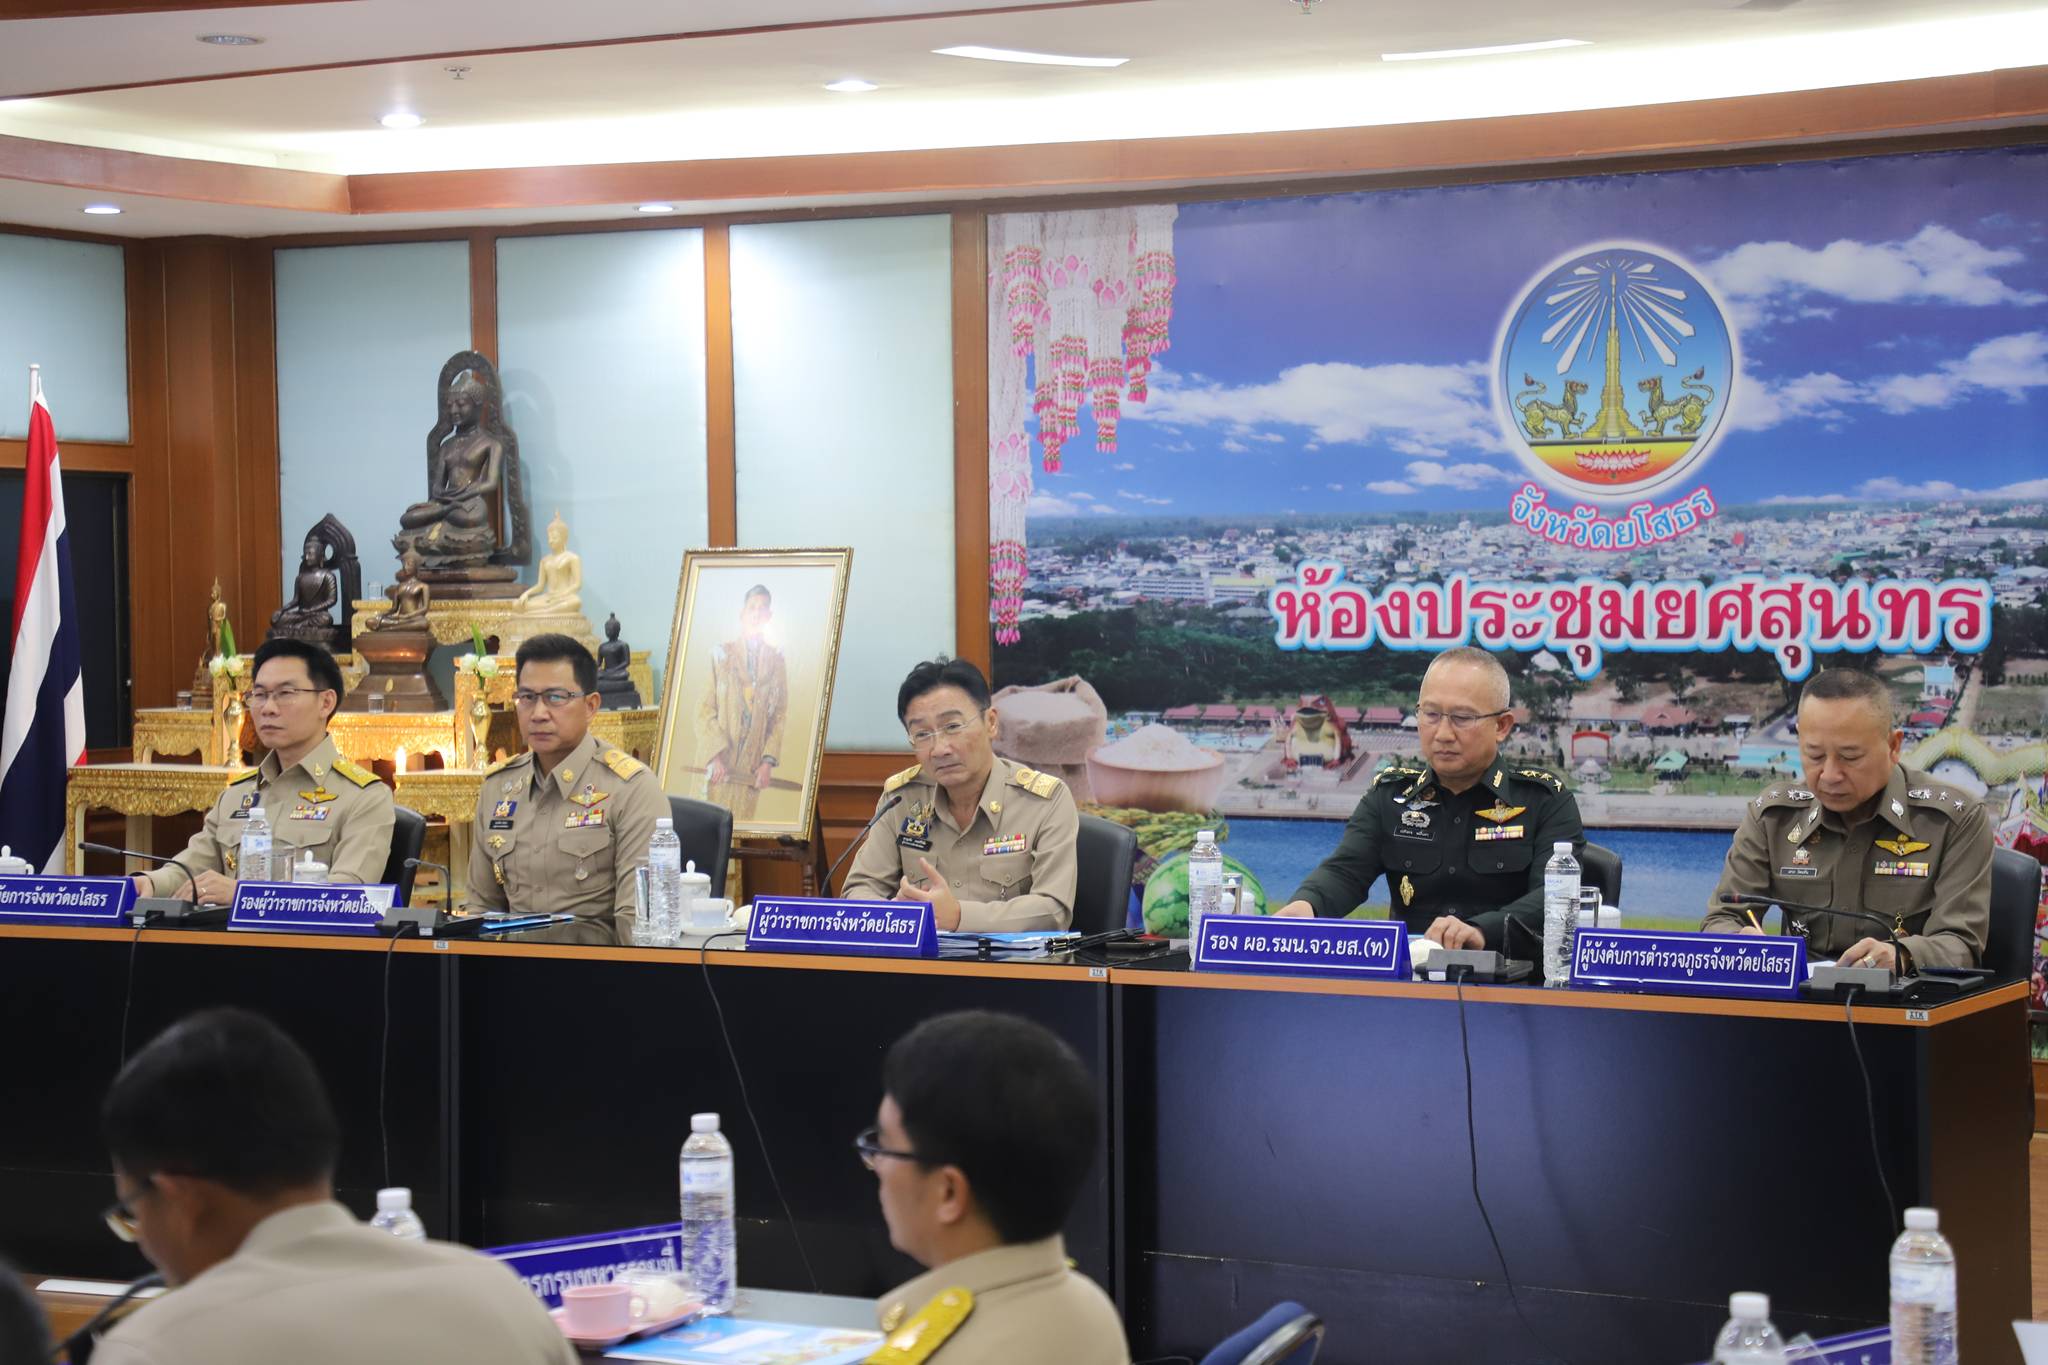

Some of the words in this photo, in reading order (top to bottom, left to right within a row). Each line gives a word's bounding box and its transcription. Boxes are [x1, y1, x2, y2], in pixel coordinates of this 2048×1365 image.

[1512, 483, 1716, 549] จังหวัดยโสธร
[1274, 561, 1991, 675] ห้องประชุมยศสุนทร
[758, 906, 917, 935] ผู้ว่าราชการจังหวัดยโสธร
[1209, 935, 1238, 951] รอง
[1580, 939, 1792, 977] ผู้บังคับการตำรวจภูธรจังหวัดยโสธร
